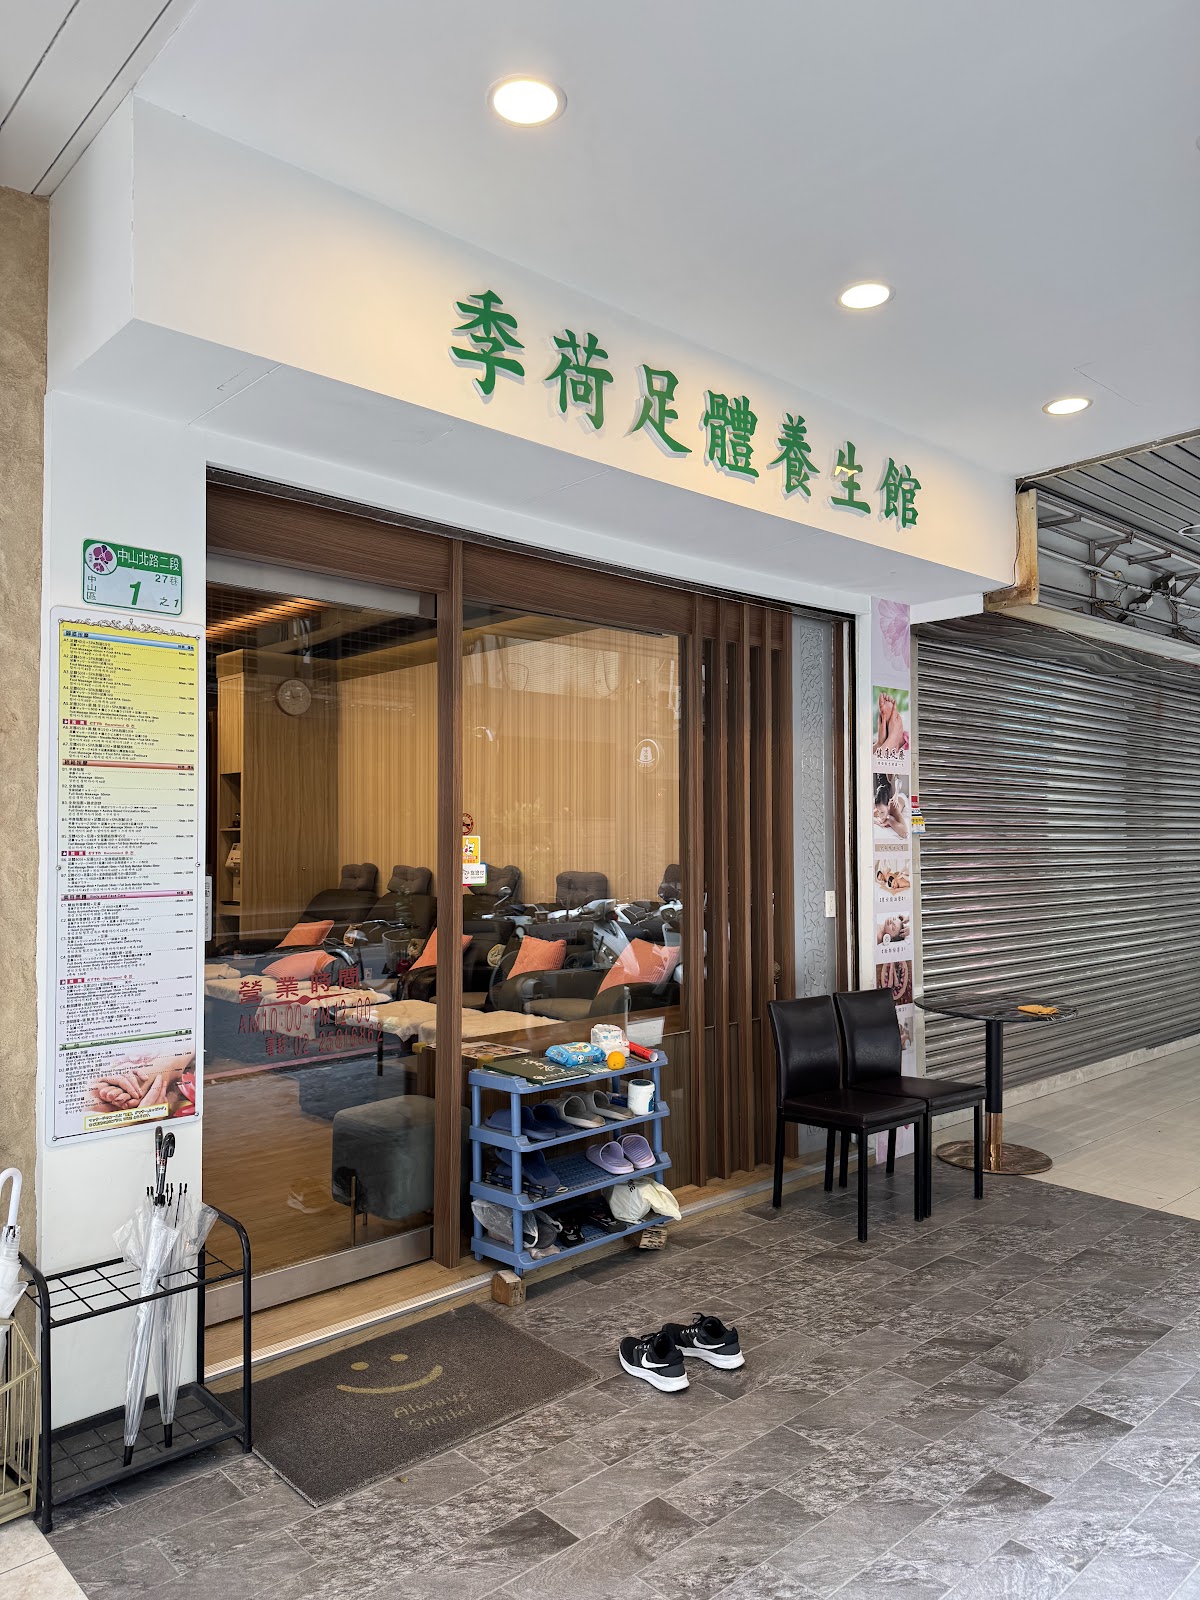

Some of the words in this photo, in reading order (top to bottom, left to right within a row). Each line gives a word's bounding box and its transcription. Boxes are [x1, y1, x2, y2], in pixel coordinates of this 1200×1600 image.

[449, 289, 922, 529] 季荷足體養生館
[117, 548, 180, 571] 中山北路二段
[87, 575, 96, 600] 中山區
[155, 574, 178, 586] 27巷
[129, 581, 141, 605] 1
[239, 967, 359, 1005] 營業時間
